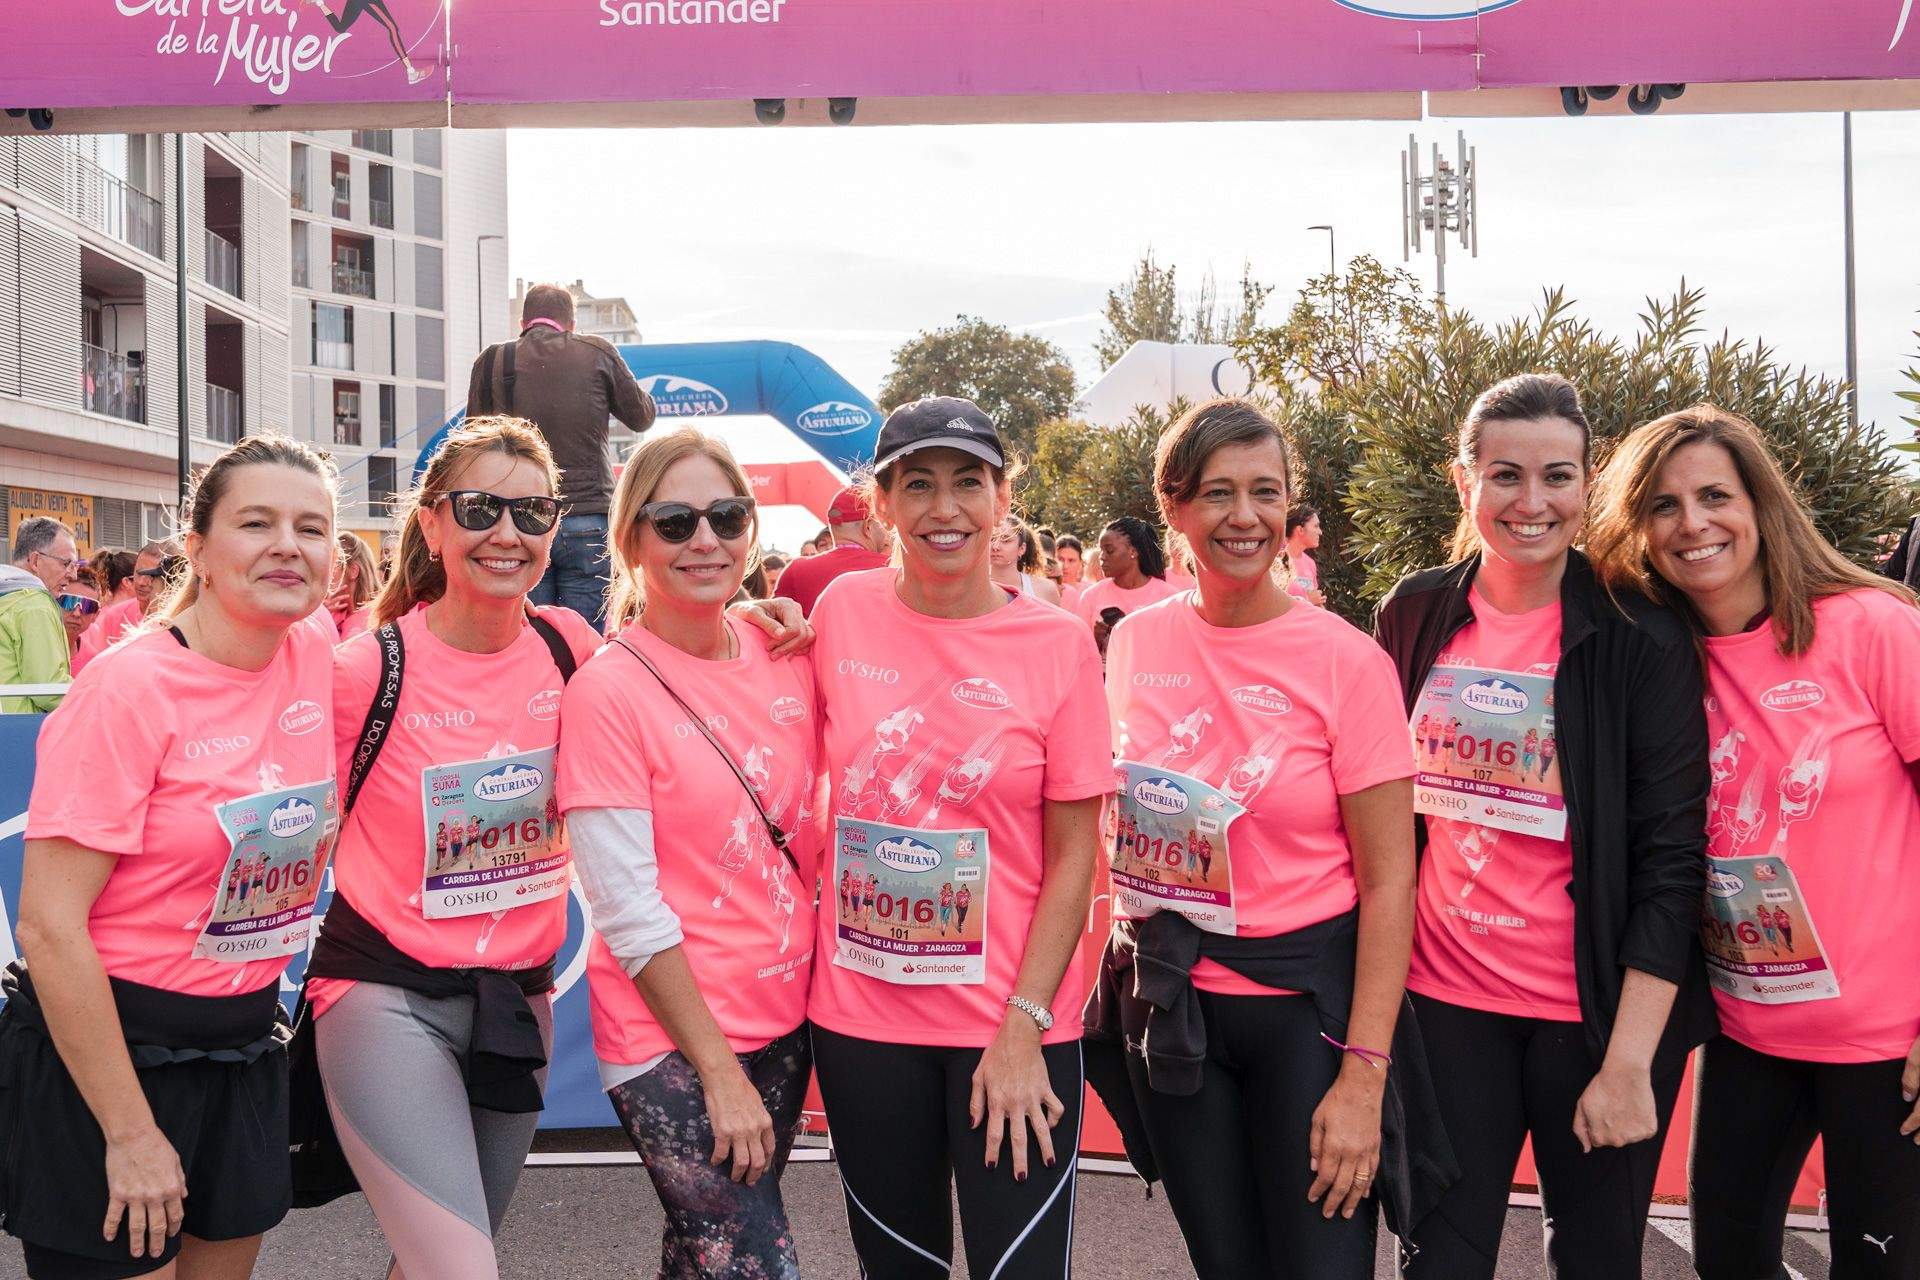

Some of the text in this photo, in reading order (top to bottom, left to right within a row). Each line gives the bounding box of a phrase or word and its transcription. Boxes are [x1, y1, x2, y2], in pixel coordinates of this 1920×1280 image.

[600, 0, 786, 27] Santander
[156, 11, 352, 95] de la Mujer
[803, 414, 867, 429] ASTURIANA
[11, 490, 43, 510] ALQUILER
[48, 494, 68, 513] VENTA
[380, 639, 400, 709] PROMESAS
[838, 658, 900, 686] OYSHO
[1133, 672, 1192, 689] OYSHO
[955, 684, 1008, 706] ASTURIANA
[1234, 691, 1286, 711] ASTURIANA
[1465, 688, 1524, 710] ASTURIANA
[1765, 691, 1820, 705] ASTURIANA
[404, 710, 476, 731] OYSHO
[674, 714, 728, 738] OYHO
[184, 735, 251, 760] OYSHO
[1457, 734, 1517, 766] 016
[1472, 768, 1493, 781] 107
[432, 780, 461, 792] SUMA
[479, 776, 539, 796] ASTURIANA
[1420, 774, 1548, 804] CARRERA DE LA MUJER ZARAGOZA
[1137, 785, 1184, 810] ASTURIANA
[1420, 792, 1545, 825] OYSHO Santander
[233, 814, 260, 827] SUMA
[272, 812, 314, 832] ASTURIANA
[481, 817, 541, 849] 016
[844, 832, 867, 844] SUMA
[492, 851, 527, 867] 13791
[880, 845, 936, 866] ASTURIANA
[1135, 833, 1184, 866] 016
[265, 859, 310, 894] 016
[443, 856, 567, 885] CARRERA DE LA MUJER ZARAGOZA
[1144, 867, 1160, 881] 102
[444, 875, 567, 907] OYSHO Santander
[1111, 871, 1217, 901] ARRERA DE LA MUJER ZARAGOZA
[275, 897, 289, 912] 105
[876, 893, 934, 923] 016
[225, 921, 257, 933] CARRERA
[258, 919, 267, 928] DE
[268, 918, 276, 926] LA
[1180, 909, 1217, 922] tander
[1471, 911, 1481, 922] DE
[1484, 914, 1494, 925] LA
[1496, 915, 1526, 928] MUJER
[849, 930, 966, 952] CARRERA DE LA MUJER ZARAGOZA
[890, 927, 910, 940] 101
[216, 937, 268, 953] OYSHO
[757, 963, 786, 979] CARRERA
[786, 959, 795, 970] DE
[849, 948, 965, 973] OYSHO Santander
[1765, 962, 1808, 973] ZARAGOZA
[1762, 981, 1815, 994] Santander
